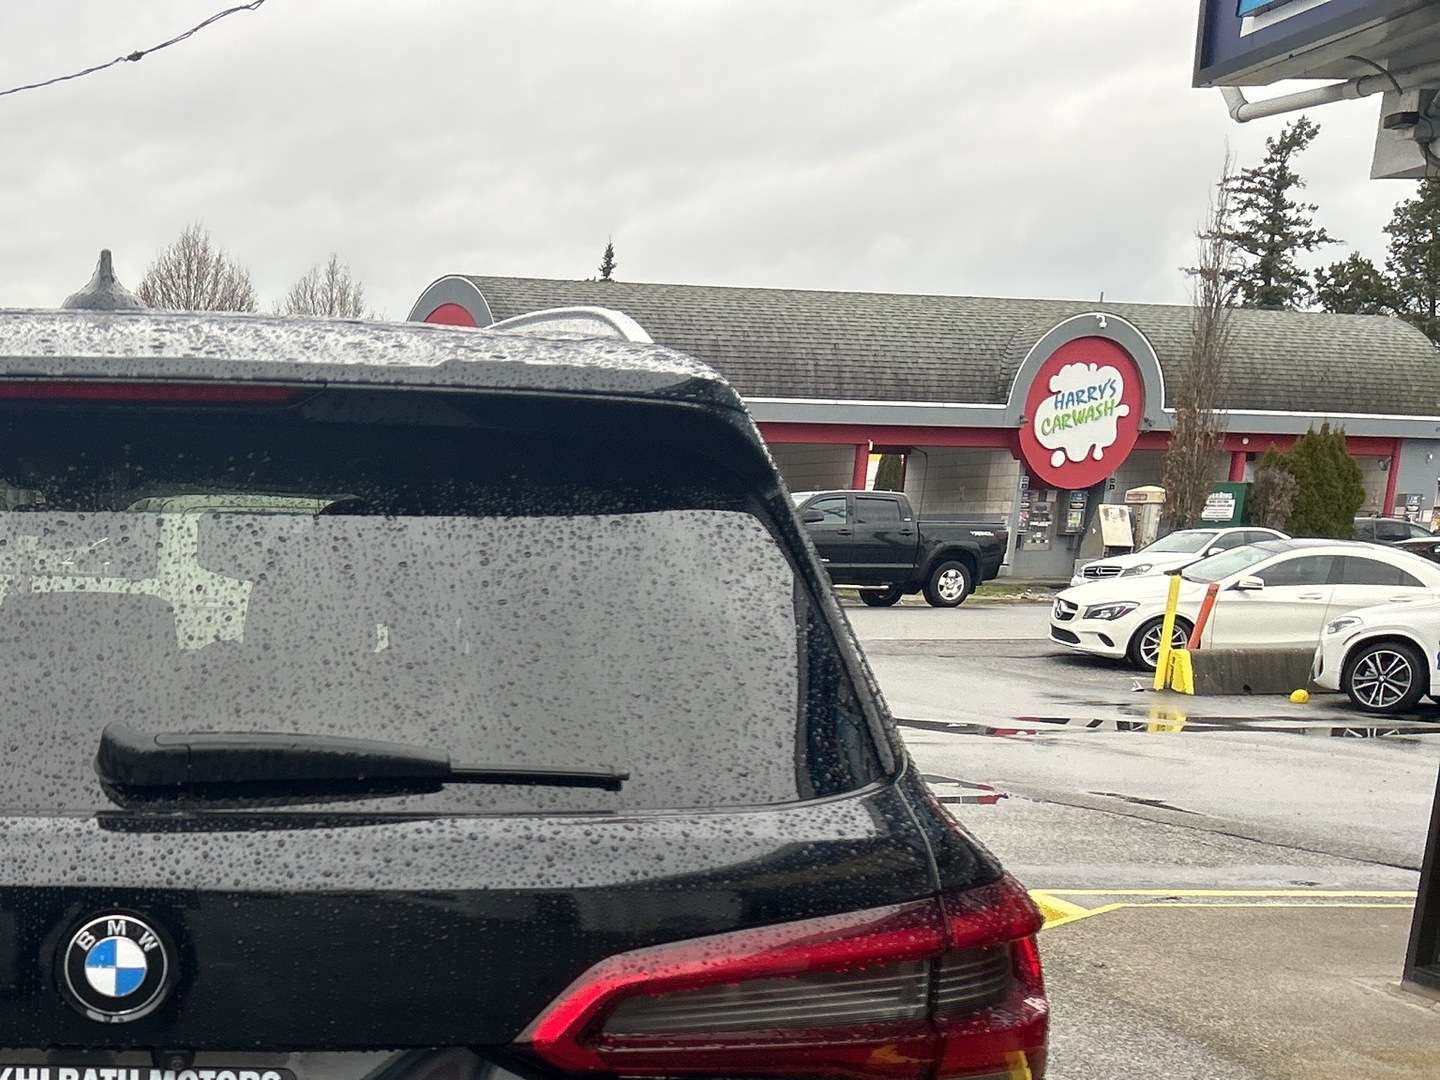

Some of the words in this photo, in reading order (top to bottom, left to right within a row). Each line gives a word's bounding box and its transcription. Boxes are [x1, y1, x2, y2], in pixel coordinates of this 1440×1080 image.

[1054, 378, 1117, 410] HARRY'S
[1041, 399, 1115, 436] CARWASH
[76, 919, 159, 952] BMW
